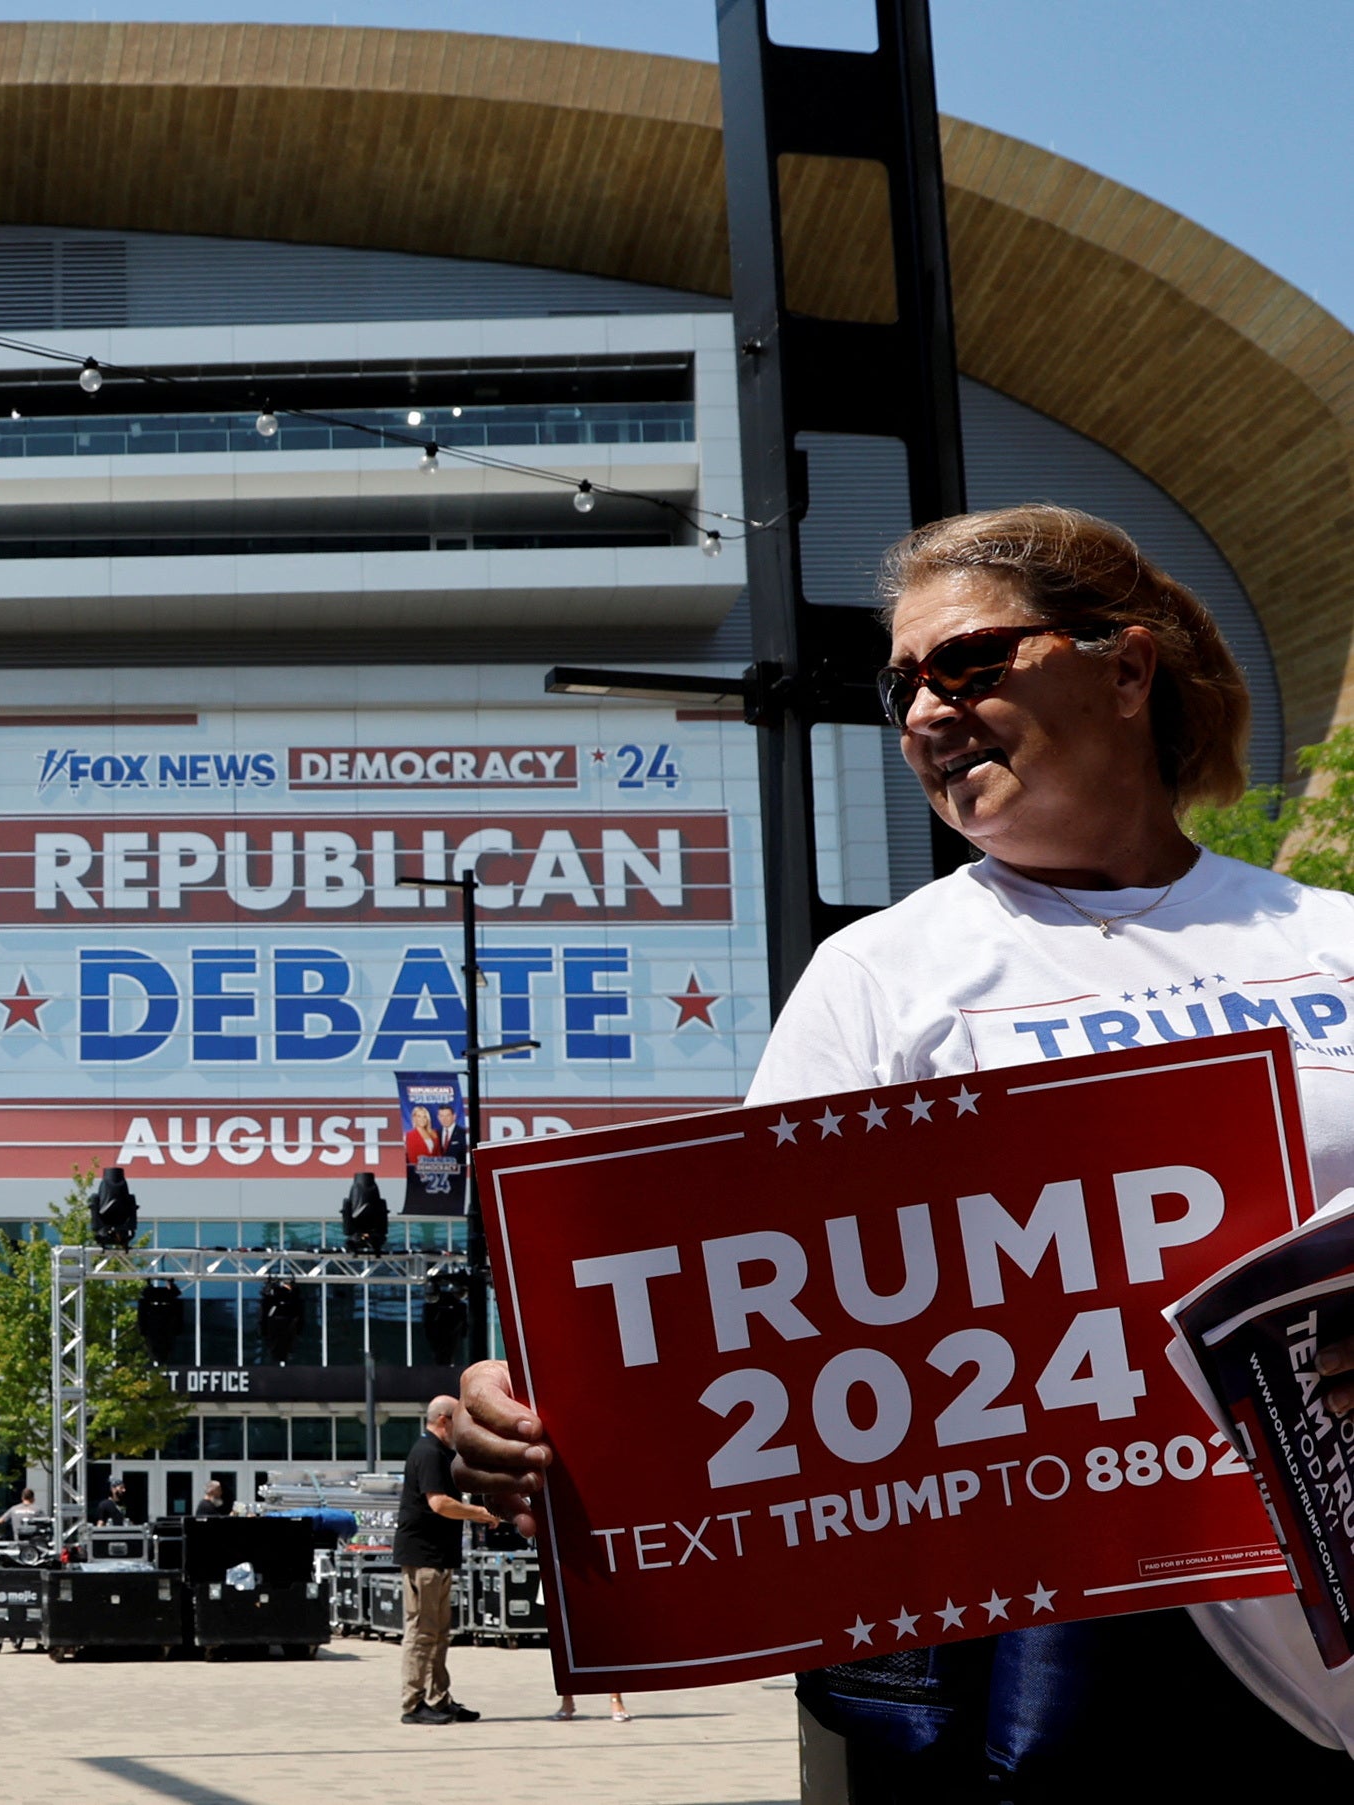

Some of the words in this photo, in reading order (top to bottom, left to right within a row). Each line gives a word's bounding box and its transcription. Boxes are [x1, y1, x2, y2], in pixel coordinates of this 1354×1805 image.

[70, 754, 149, 788] FOX
[158, 753, 276, 787] NEWS
[299, 750, 565, 782] DEMOCRACY
[616, 744, 679, 788] 24
[35, 828, 683, 910] REPUBLICAN
[78, 947, 633, 1063] DEBATE
[1014, 992, 1348, 1059] TRUMP
[117, 1117, 387, 1166] AUGUST
[572, 1165, 1225, 1367] TRUMP
[187, 1371, 249, 1392] OFFICE
[698, 1307, 1147, 1489] 2024
[1287, 1310, 1333, 1440] TEAM
[1327, 1441, 1354, 1558] TRU
[590, 1510, 751, 1572] TEXT
[769, 1469, 981, 1547] TRUMP
[987, 1454, 1070, 1506] TO
[1250, 1352, 1350, 1623] WWW.DONALDJTRUMP.COM/JOIN
[1294, 1413, 1338, 1532] TODAY!
[1186, 1556, 1213, 1565] DONALD
[1245, 1550, 1259, 1558] FOR
